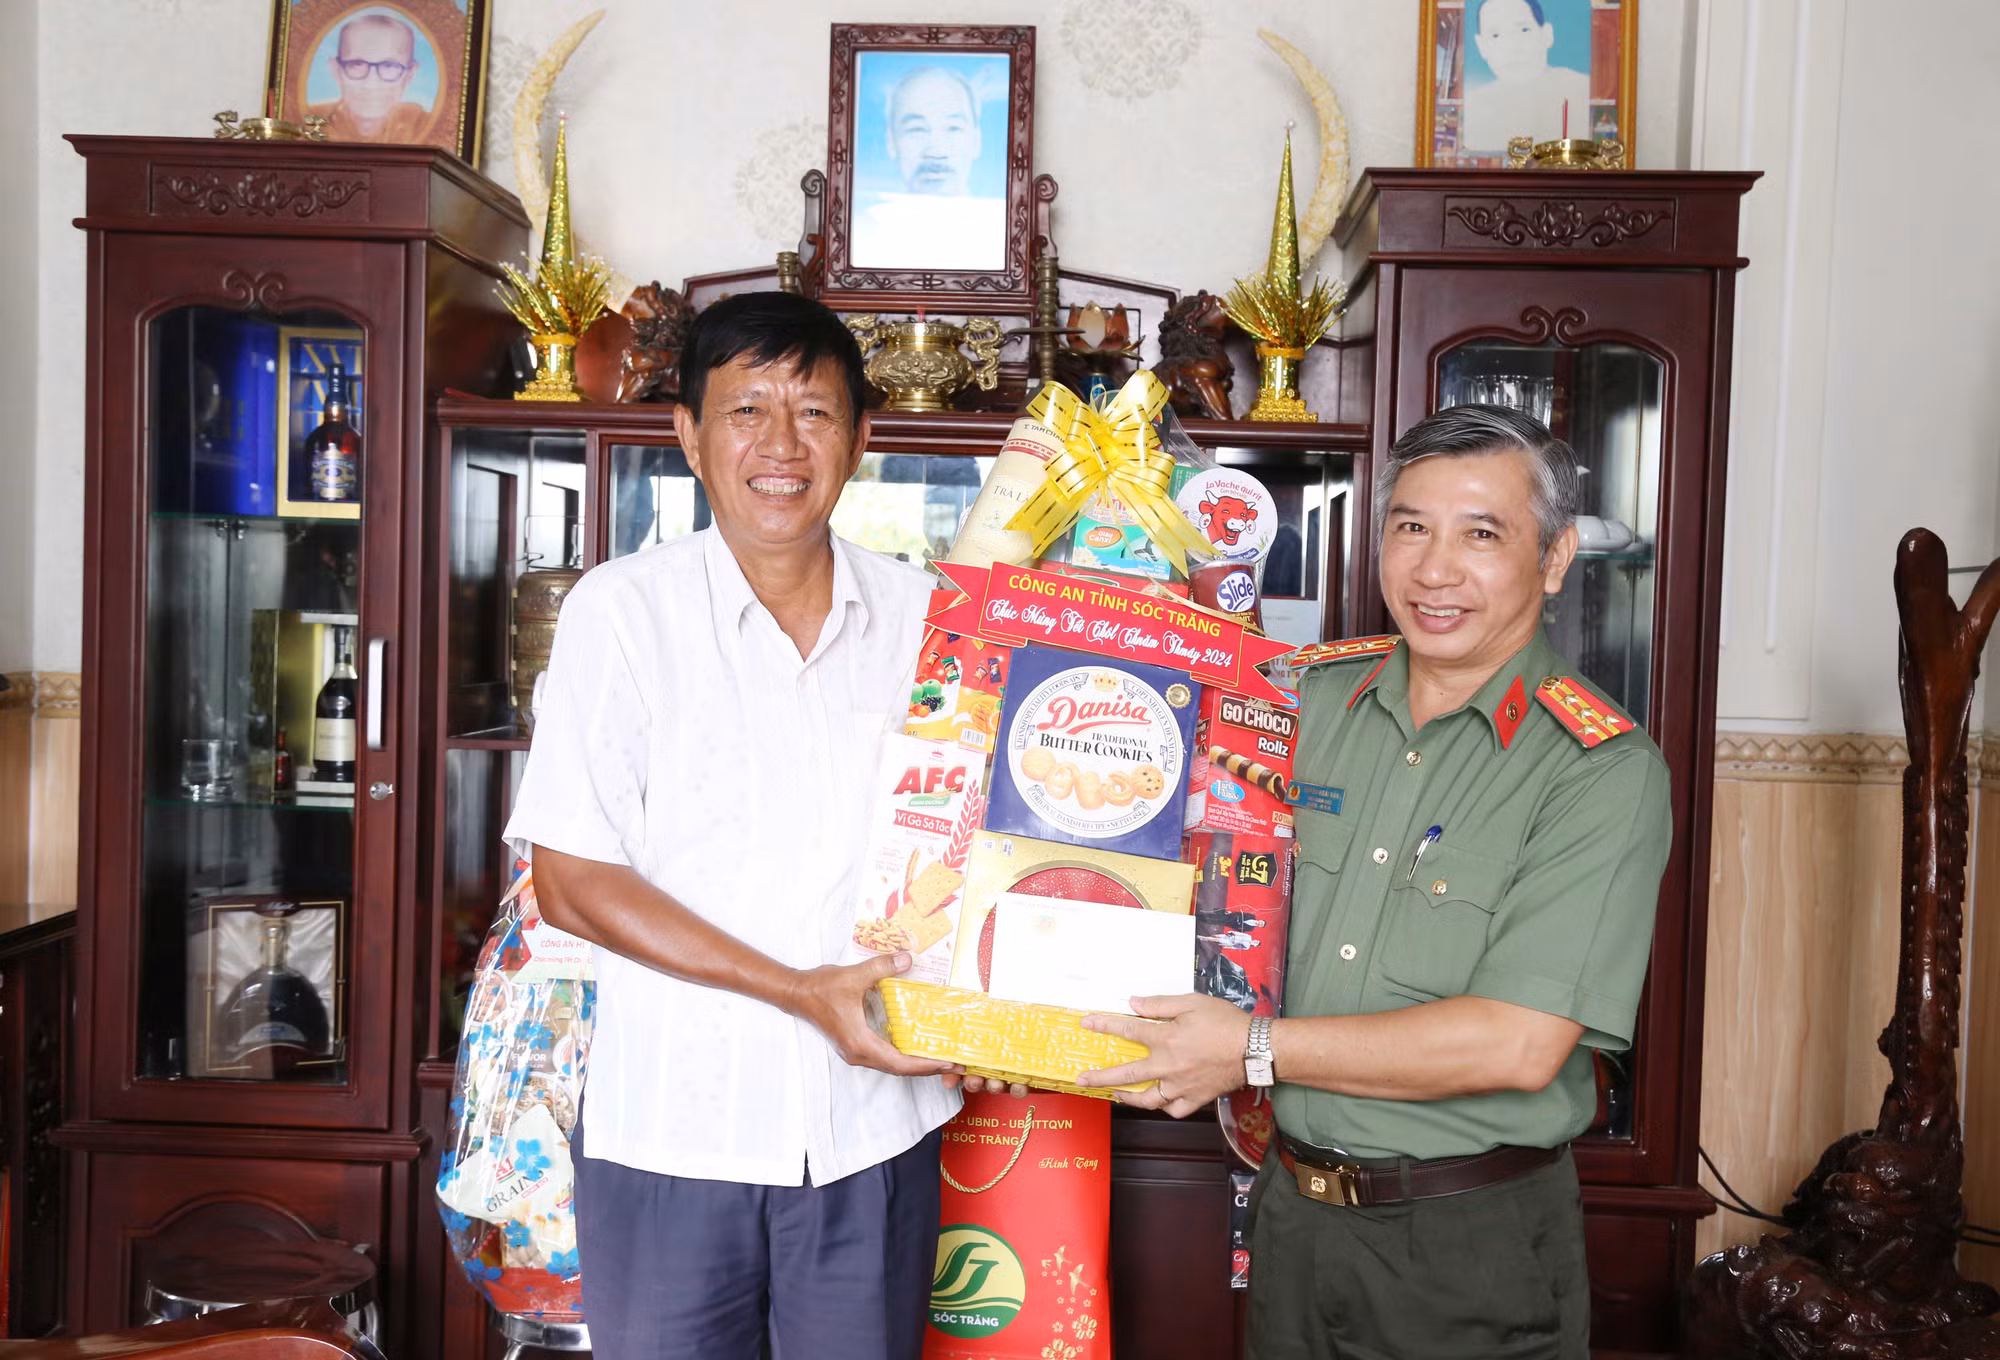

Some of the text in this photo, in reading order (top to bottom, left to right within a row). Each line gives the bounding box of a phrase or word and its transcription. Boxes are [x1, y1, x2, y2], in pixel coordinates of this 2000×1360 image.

[1205, 480, 1262, 501] La Vache qui rit
[1217, 576, 1254, 610] Slide
[1008, 574, 1057, 596] CÔNG
[1060, 585, 1085, 602] AN
[1089, 588, 1128, 612] TỈNH
[1131, 600, 1164, 620] SÓC
[1167, 609, 1221, 637] TRĂNG
[985, 599, 1019, 625] Chúc
[1201, 647, 1234, 667] 2024
[1036, 694, 1152, 735] Danisa
[1222, 702, 1291, 735] GO CHOCO
[1040, 733, 1153, 763] BUTTER COOKIES
[1092, 733, 1149, 749] TRADITIONAL
[1258, 737, 1289, 757] Rollz
[892, 766, 967, 795] AFC
[896, 811, 907, 825] Vị
[907, 814, 922, 827] Gà
[1274, 812, 1283, 822] 20
[1250, 855, 1268, 885] G7
[563, 941, 574, 949] AN
[967, 1118, 999, 1128] UBND
[952, 1131, 976, 1143] SÓC
[979, 1134, 1020, 1146] TRĂNG
[1038, 1157, 1069, 1169] Kính
[933, 1311, 999, 1327] SÓC TRĂNG
